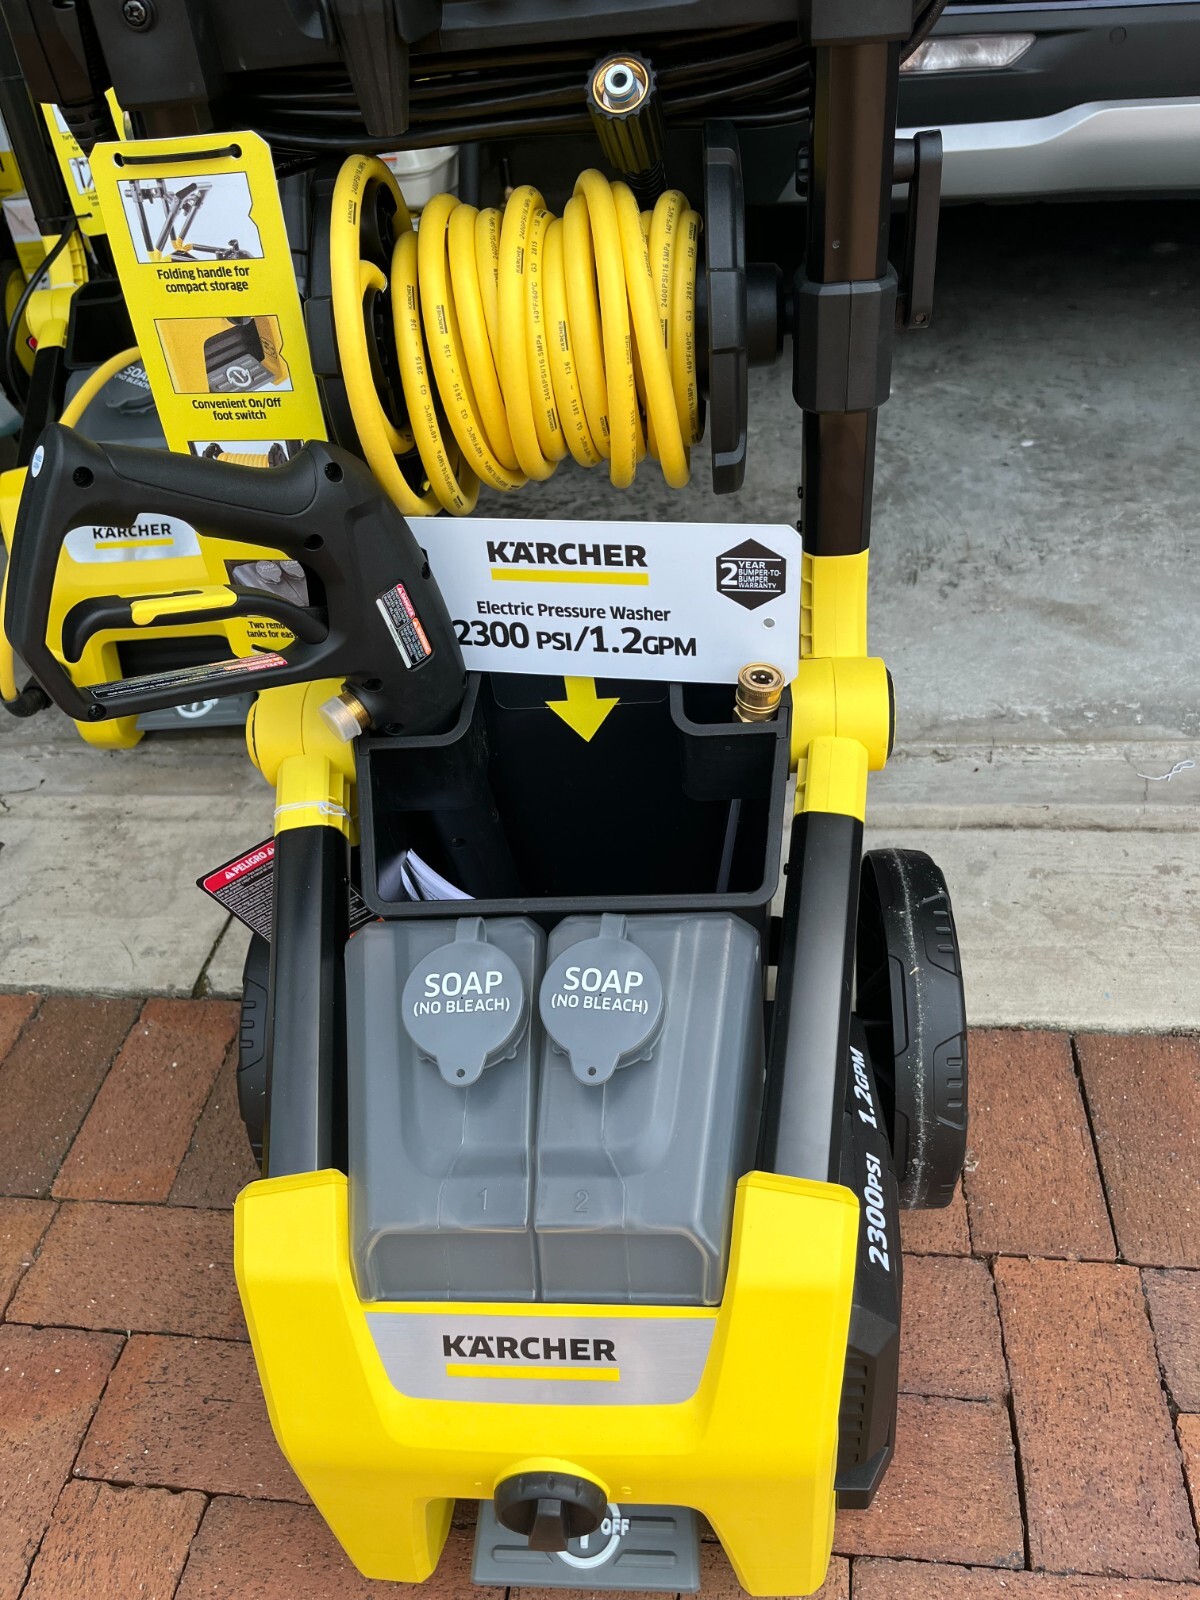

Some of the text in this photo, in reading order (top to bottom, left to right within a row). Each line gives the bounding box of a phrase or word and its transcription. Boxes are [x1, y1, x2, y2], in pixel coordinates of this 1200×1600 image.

[157, 265, 250, 281] Folding handle for
[165, 280, 249, 294] compact storage
[124, 366, 149, 381] SOA
[415, 356, 424, 375] 2815
[192, 397, 281, 409] Convenient On/Off
[213, 409, 267, 421] foot switch
[486, 541, 648, 567] KÄRCHER
[720, 562, 738, 586] 2
[738, 560, 766, 569] YEAR
[738, 568, 782, 577] BUMPER-TO-
[738, 575, 769, 583] BUMPER
[476, 601, 672, 622] Electric Pressure Washer
[247, 630, 267, 638] tanks
[268, 630, 279, 638] for
[248, 621, 265, 629] Two
[452, 619, 530, 649] 2300
[536, 625, 697, 656] PSI/1.2GPM
[232, 851, 268, 875] PELIGRO
[424, 970, 504, 998] SOAP
[563, 966, 644, 995] SOAP
[413, 997, 511, 1017] (NO BLEACH)
[551, 993, 649, 1015] (NO BLEACH)
[849, 1045, 878, 1130] 1.2GPM
[442, 1334, 618, 1361] KÄRCHER
[600, 1518, 630, 1536] OFF
